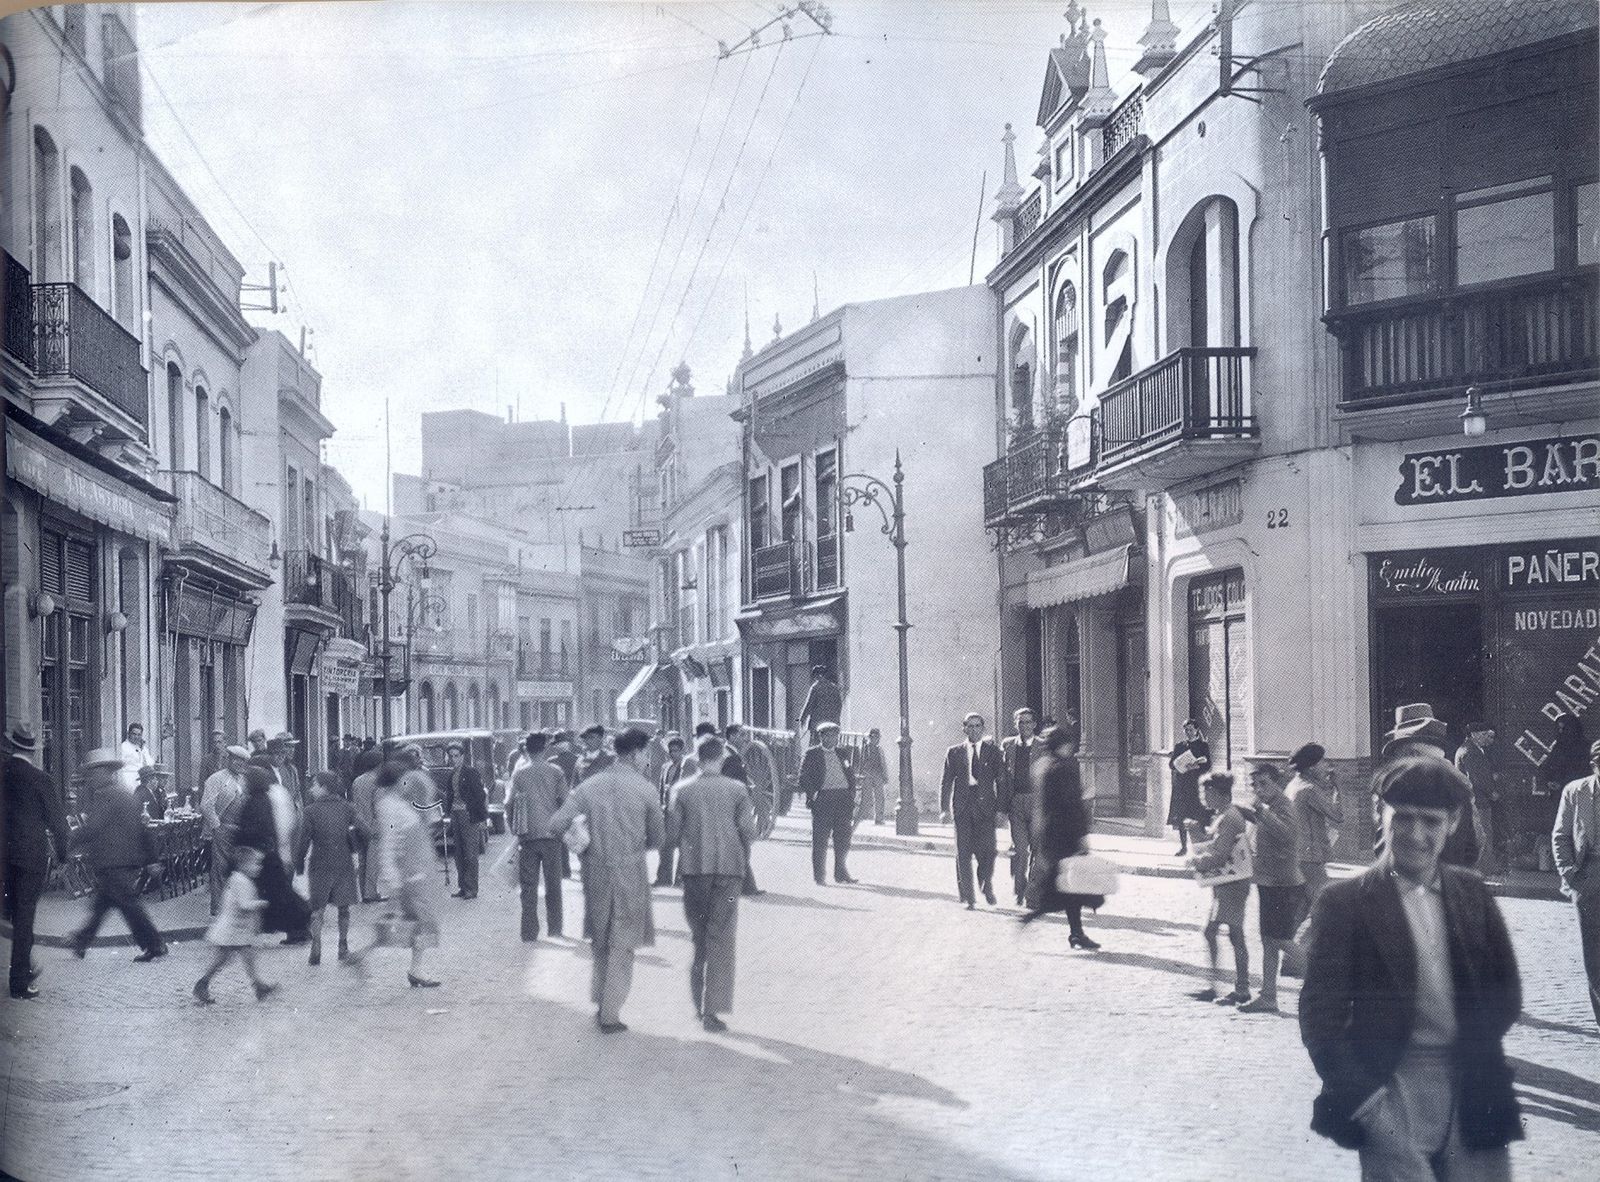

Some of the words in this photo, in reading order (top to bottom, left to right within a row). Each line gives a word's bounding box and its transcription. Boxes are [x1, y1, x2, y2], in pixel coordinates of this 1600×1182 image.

[1410, 454, 1484, 498] EL
[1503, 439, 1600, 489] BAR
[1266, 507, 1290, 530] 22
[1379, 557, 1435, 590] Emilio
[1507, 548, 1600, 585] PAÑER
[1514, 608, 1600, 631] NOVEDAD
[1513, 728, 1558, 767] EL
